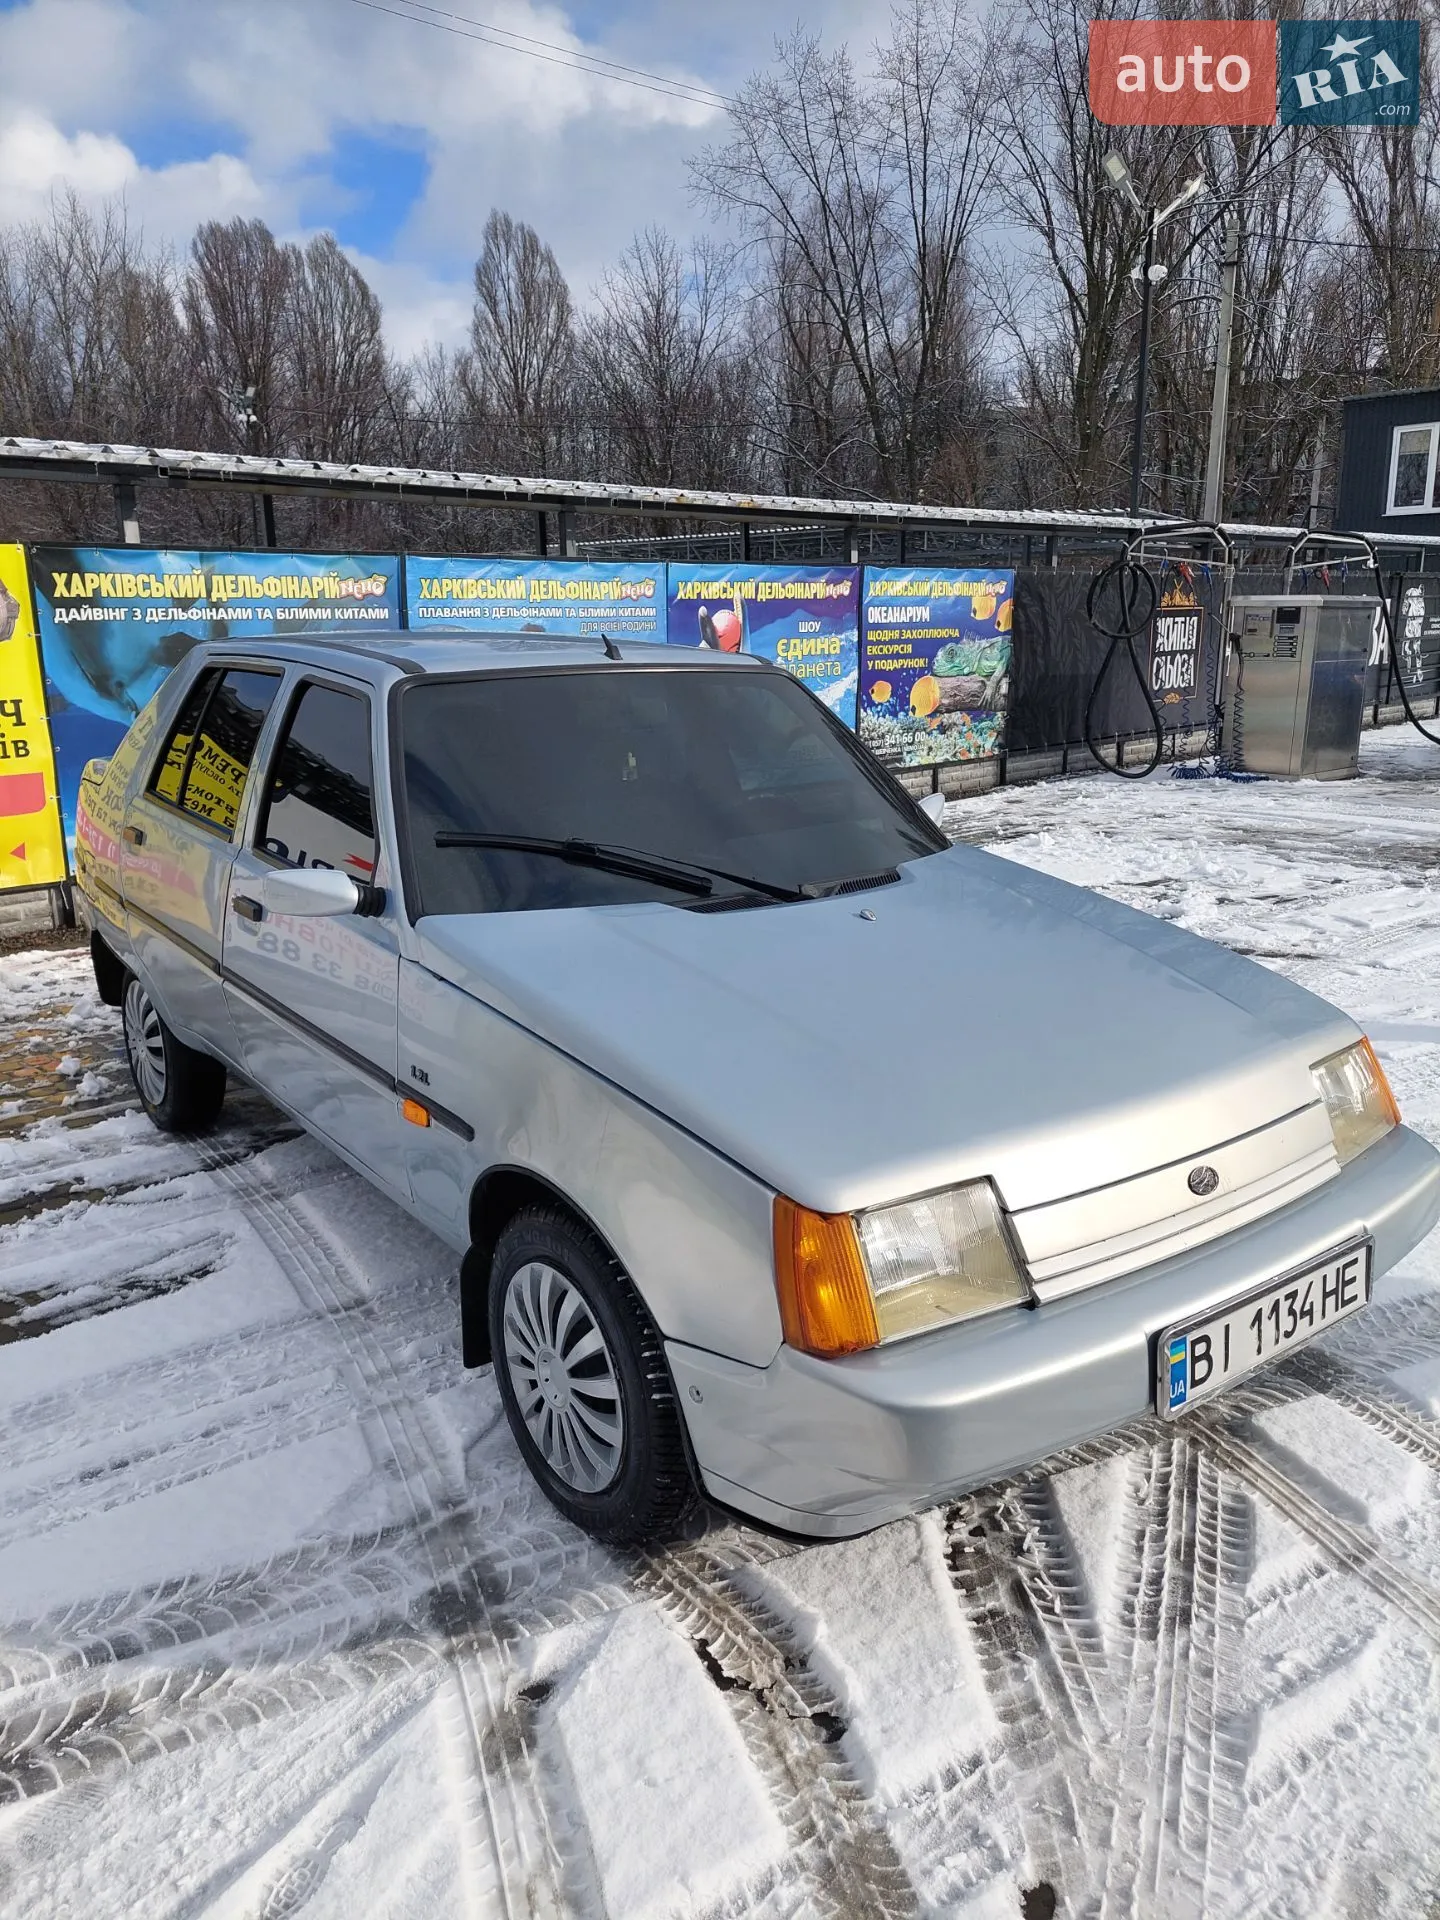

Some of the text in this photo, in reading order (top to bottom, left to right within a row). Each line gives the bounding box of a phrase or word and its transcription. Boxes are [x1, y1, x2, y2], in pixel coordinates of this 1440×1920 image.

[51, 569, 207, 598] ХАРКІВСЬКИЙ
[211, 571, 340, 602] ДЕЛЬФІНАРІЙ
[420, 576, 526, 599] ХАРКІВСЬКИЙ
[529, 577, 621, 602] ДЕЛЬФІНАРІЙ
[678, 579, 756, 599] ХАРКІВСЬКИЙ
[757, 579, 826, 601] ДЕЛЬФІНАРІЙ
[868, 579, 930, 597] ХАРКІВСЬКИЙ
[931, 579, 986, 598] ДЕЛЬФІНАРІЙ
[54, 605, 389, 623] ДАЙВІНГ З ДЕЛЬФІНАМИ ТА БІЛИМИ КИТАМИ
[419, 607, 481, 618] ПЛАВАННЯ
[491, 606, 563, 620] ДЕЛЬФІНАМИ
[565, 608, 577, 618] ТА
[579, 607, 617, 618] БІЛИМИ
[618, 607, 657, 617] КИТАМИ
[868, 606, 930, 623] ОКЕАНАРІУМ
[580, 622, 598, 632] ДЛЯ
[622, 622, 657, 632] РОДИНИ
[798, 621, 821, 633] ШОУ
[867, 628, 960, 641] ЩОДНЯ ЗАХОПЛЮЮЧА
[867, 644, 912, 656] ЕКСКУРСІЯ
[867, 658, 929, 671] У ПОДАРУНОК!
[1190, 1257, 1359, 1390] BI 1134 HE
[1169, 1380, 1185, 1399] UA
